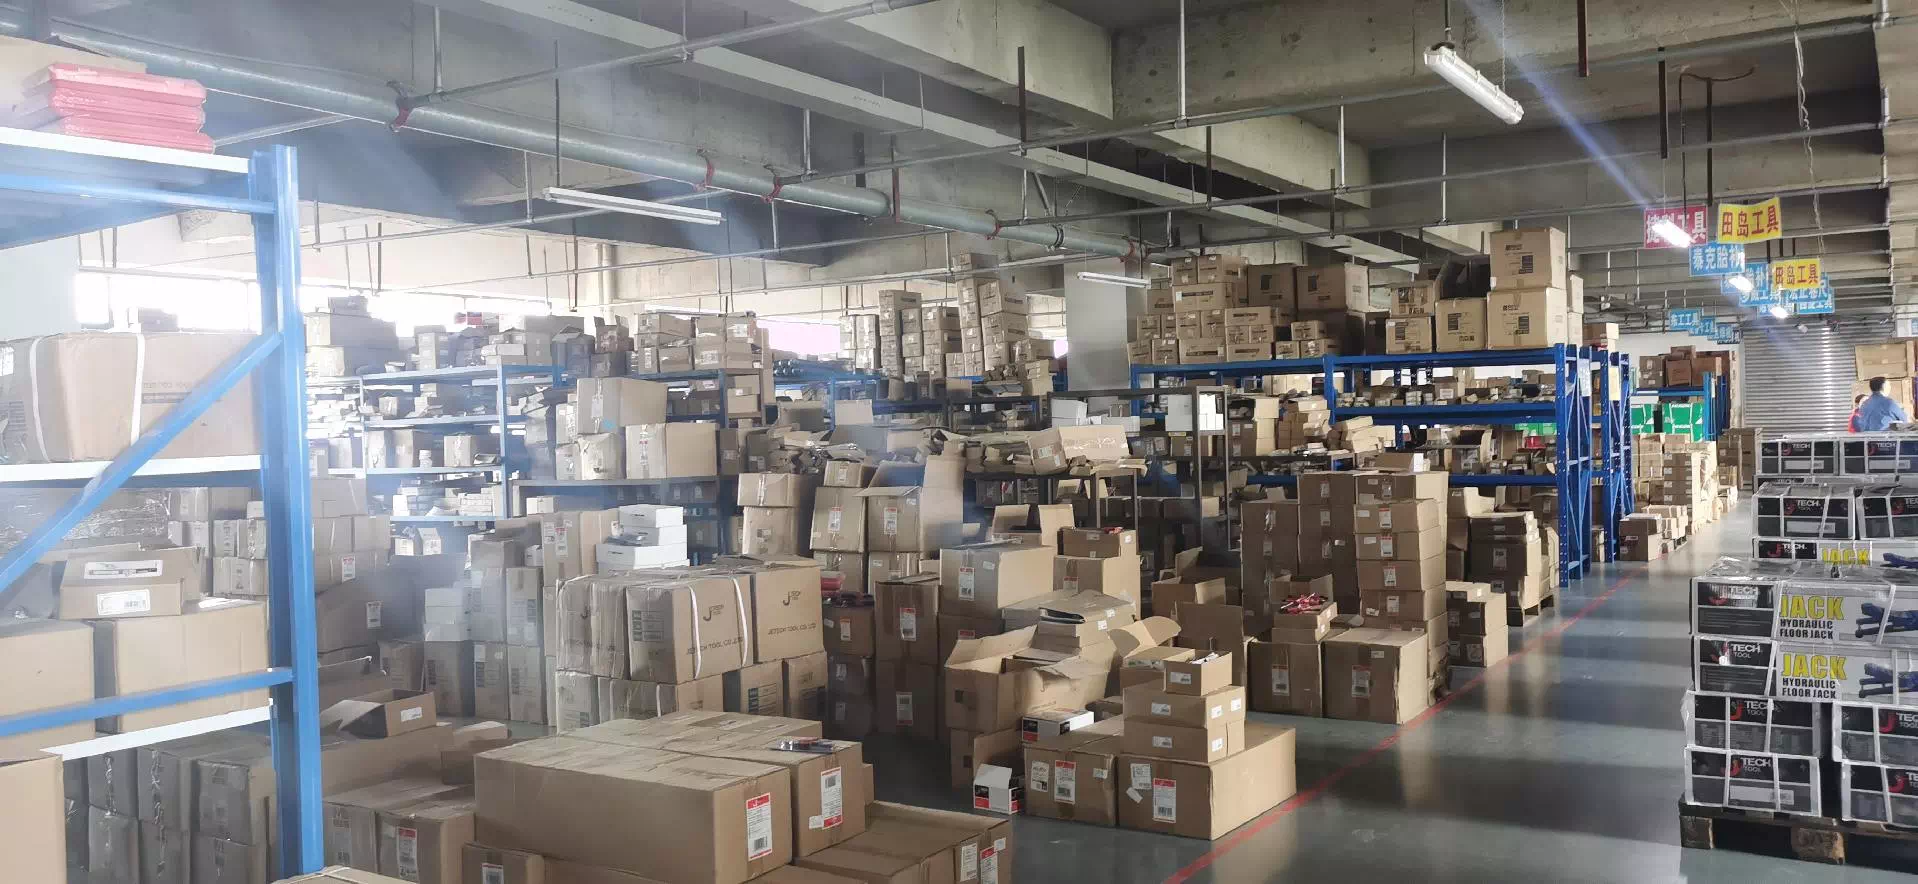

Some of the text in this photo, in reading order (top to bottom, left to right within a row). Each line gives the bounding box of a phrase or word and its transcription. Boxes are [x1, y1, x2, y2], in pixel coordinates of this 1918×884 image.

[1722, 205, 1778, 237] 田岛工具
[1775, 264, 1818, 285] 田岛工具
[1797, 499, 1819, 507] TECH
[1779, 595, 1844, 620] JACK
[1780, 619, 1833, 629] HYDRAULIC
[1780, 628, 1834, 640] FLOOR JACK
[1730, 643, 1761, 653] TECH
[1781, 653, 1848, 680] JACK
[1782, 678, 1836, 689] HYDRAULIC
[1782, 687, 1837, 699] FLOOR JACK
[1740, 757, 1772, 768] TECH
